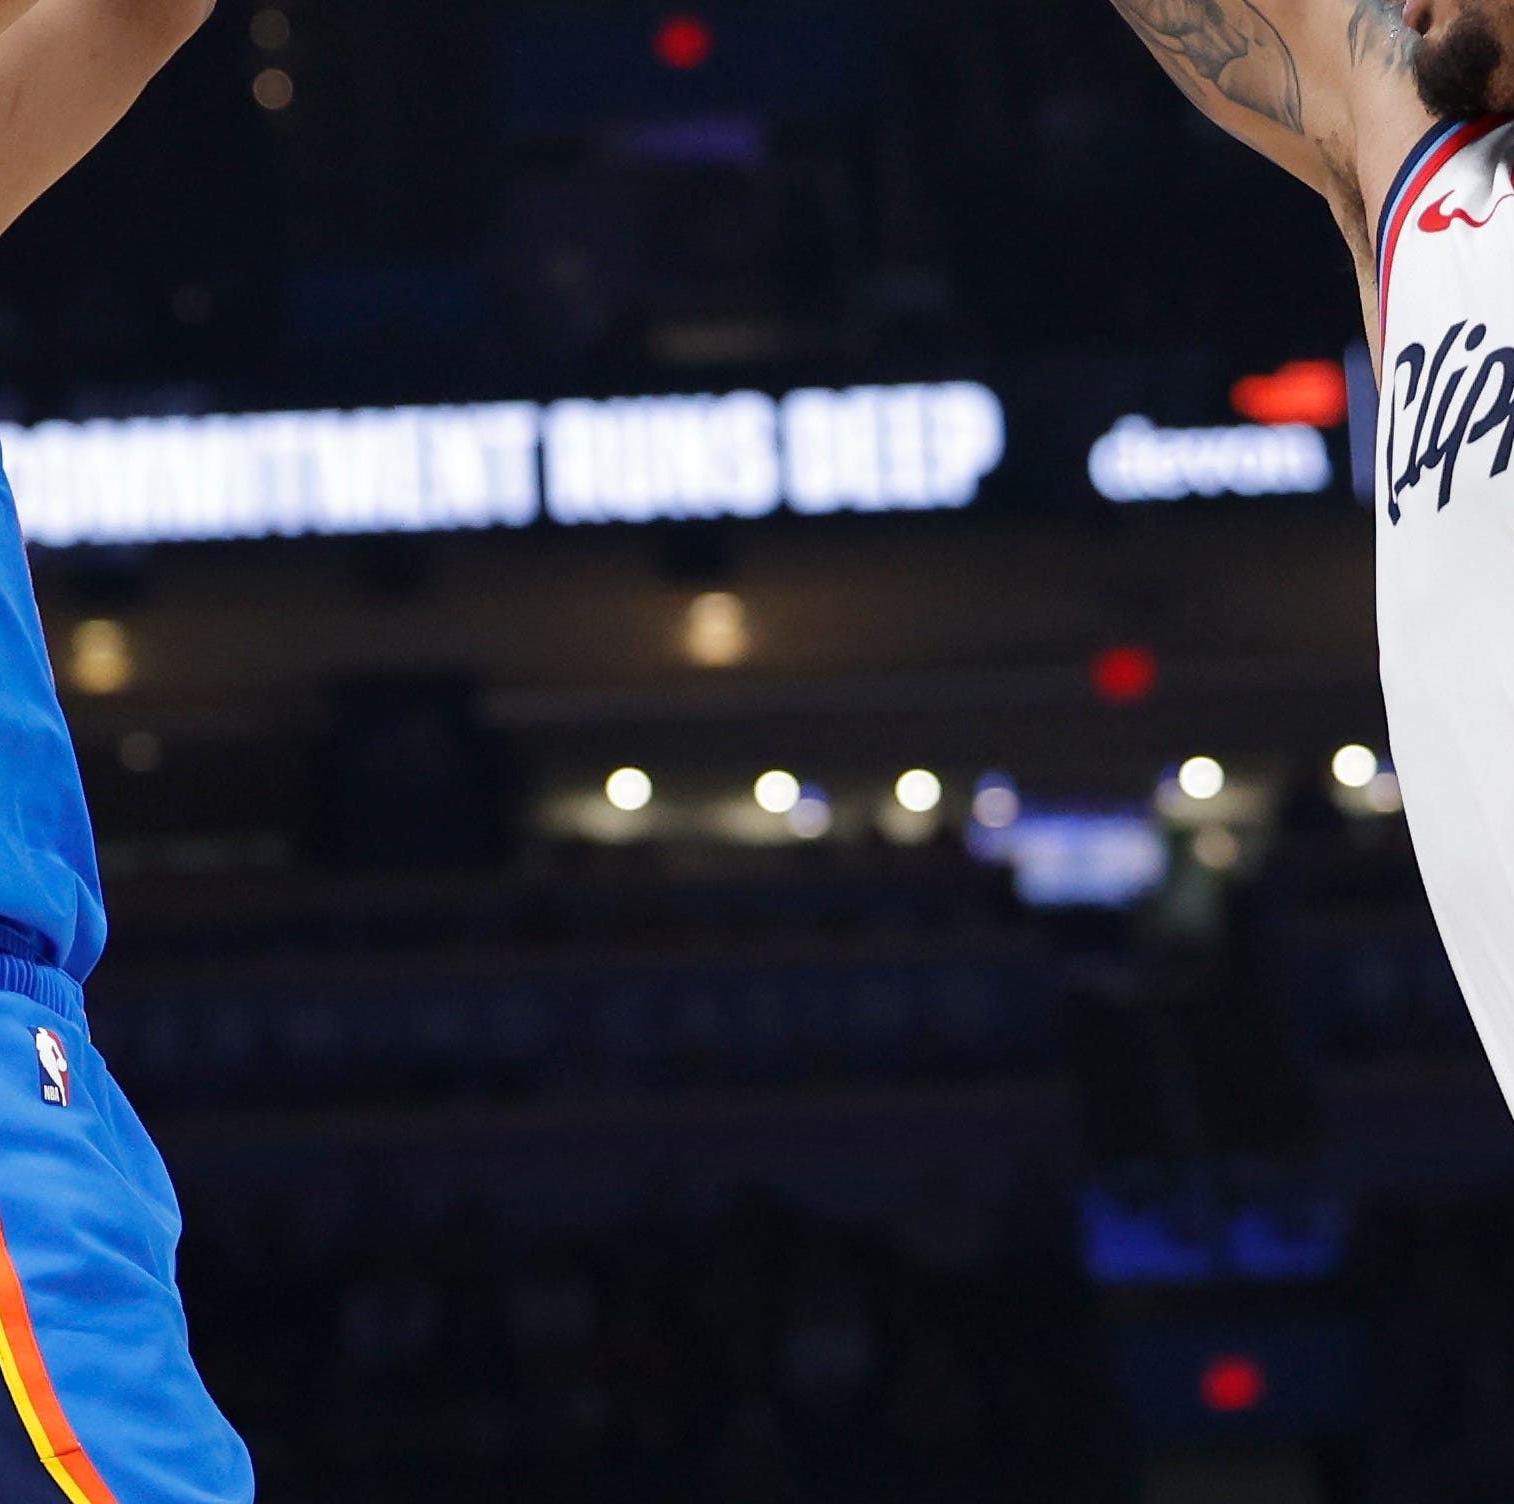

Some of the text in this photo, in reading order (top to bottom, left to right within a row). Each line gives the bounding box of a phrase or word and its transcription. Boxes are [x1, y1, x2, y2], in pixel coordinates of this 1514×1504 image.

[544, 389, 780, 525] RUNS
[783, 380, 1003, 513] DEEP
[43, 1084, 61, 1103] NBA
